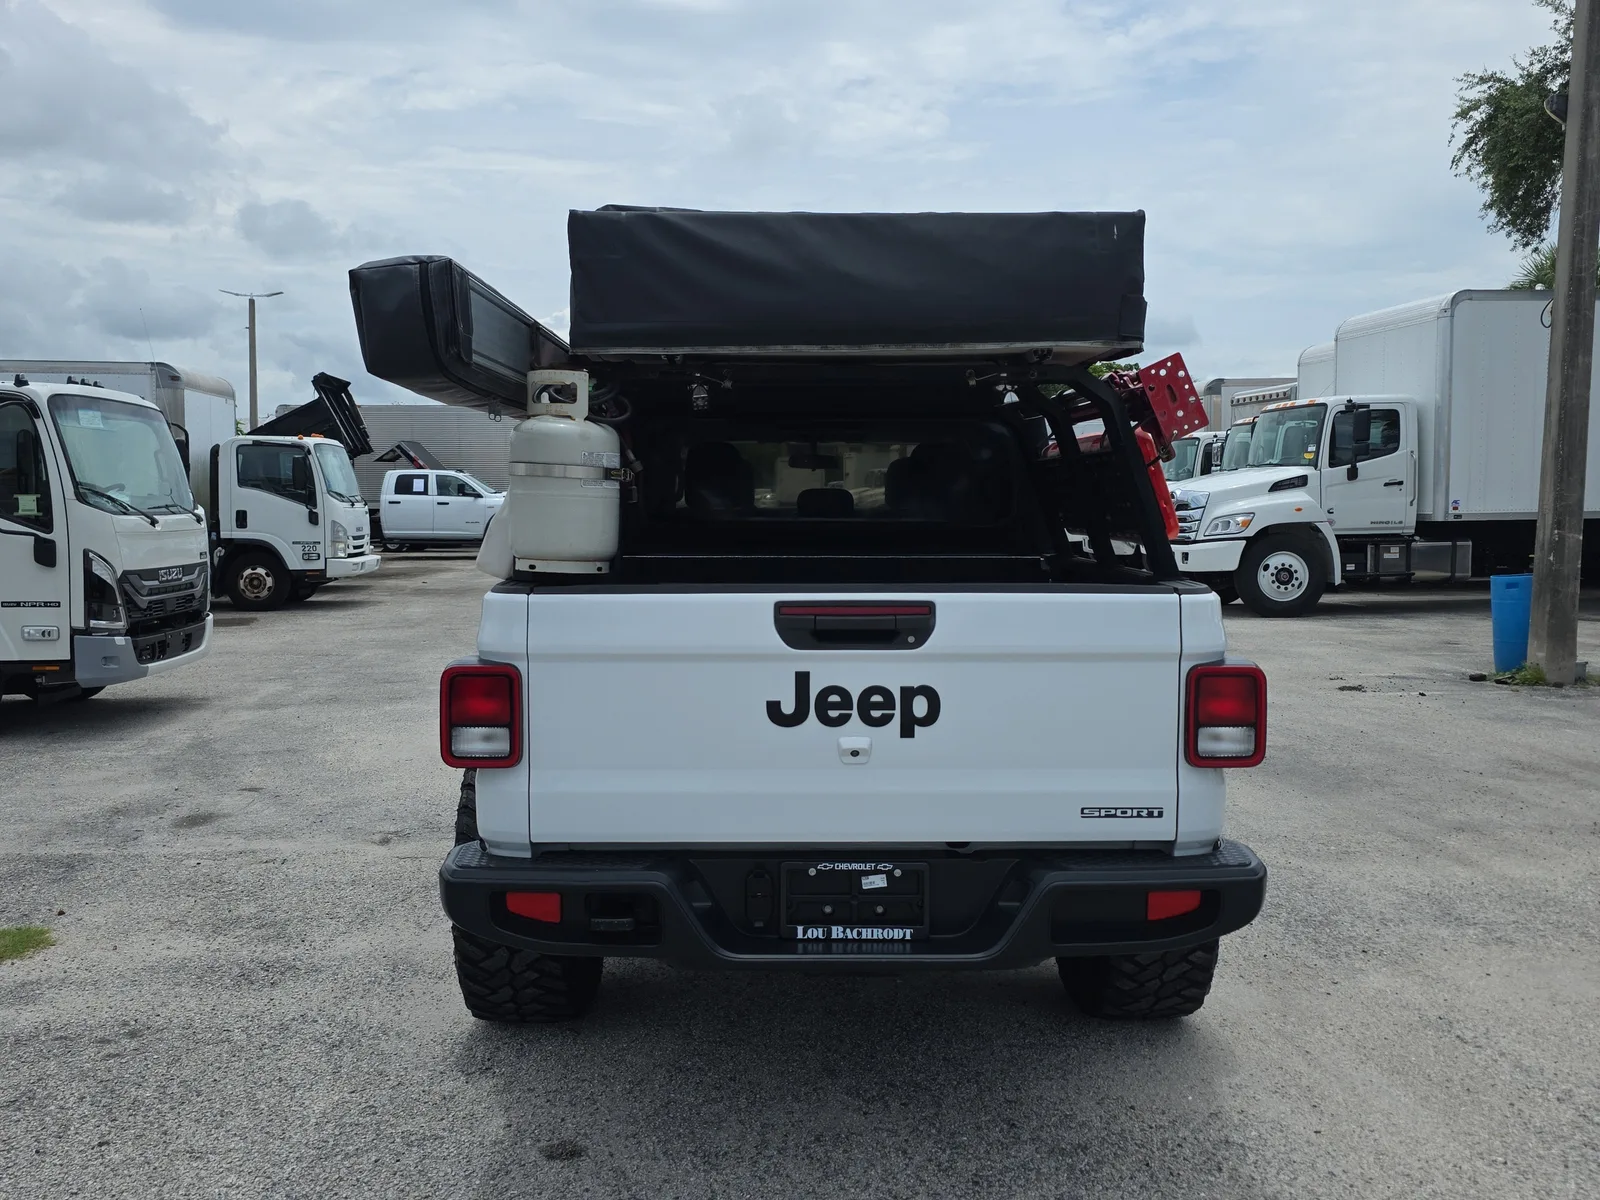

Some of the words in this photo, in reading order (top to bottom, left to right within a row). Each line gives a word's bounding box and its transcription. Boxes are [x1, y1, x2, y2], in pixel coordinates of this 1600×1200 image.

[158, 567, 183, 582] ISUZU
[766, 671, 941, 738] Jeep
[1081, 808, 1164, 817] SPORT
[834, 863, 876, 871] CHEVROLET
[796, 925, 827, 940] LOU
[830, 925, 914, 940] BACHRODT
